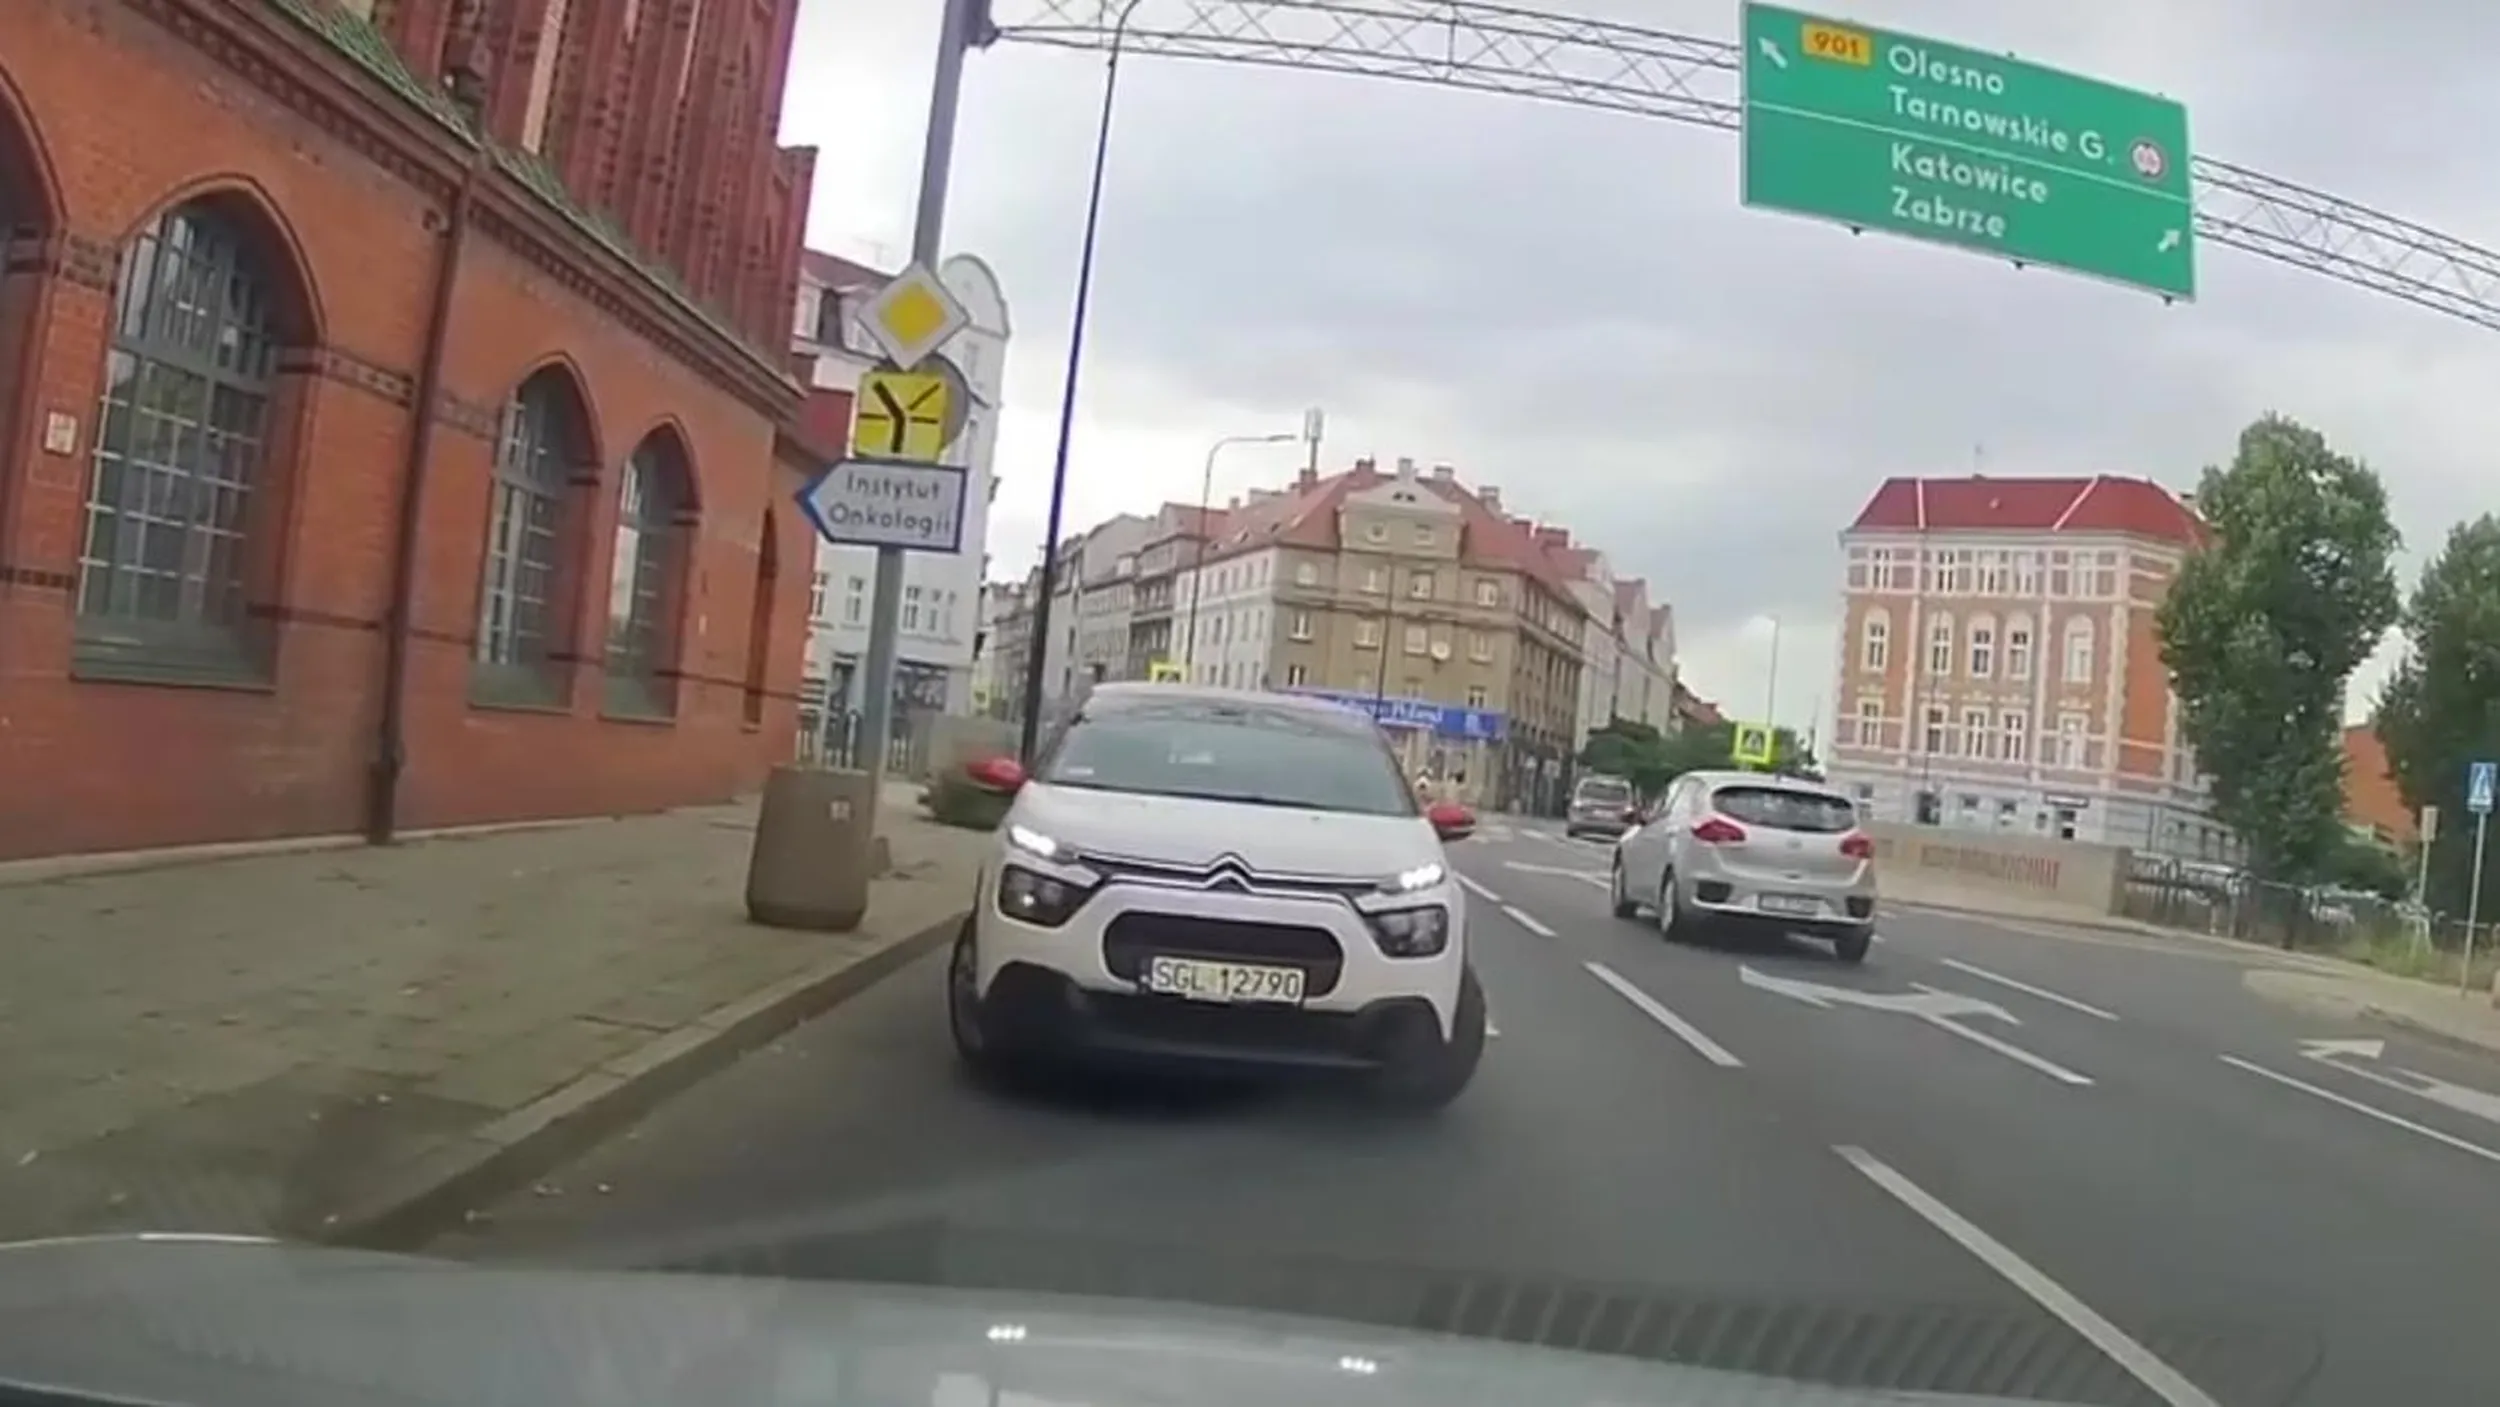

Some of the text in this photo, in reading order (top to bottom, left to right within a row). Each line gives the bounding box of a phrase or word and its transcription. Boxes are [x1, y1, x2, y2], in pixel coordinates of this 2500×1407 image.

[1813, 31, 1861, 58] 901
[1887, 45, 2004, 96] Olesno
[1888, 86, 2116, 166] Tarnowskie G.
[1891, 142, 2048, 203] Katowice
[1891, 186, 2006, 238] Zabrze
[846, 473, 941, 499] Instytut
[828, 501, 950, 538] Onkologii
[1155, 961, 1300, 999] SGL 12790
